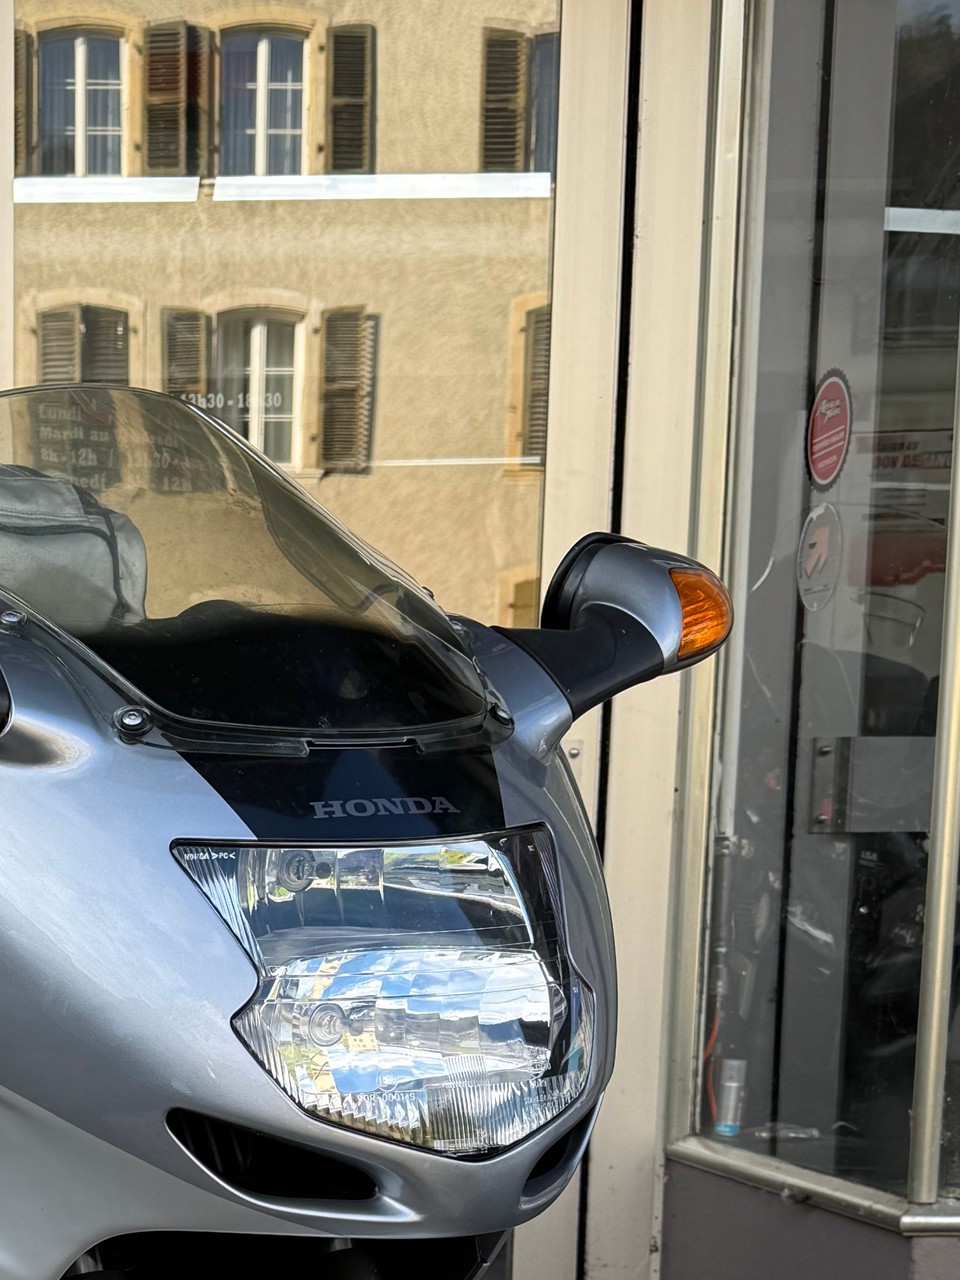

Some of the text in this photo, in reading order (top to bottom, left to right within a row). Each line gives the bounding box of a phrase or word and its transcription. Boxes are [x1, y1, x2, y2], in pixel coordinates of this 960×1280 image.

[38, 403, 82, 422] Lundi
[39, 425, 84, 441] Mardi
[308, 796, 462, 820] HONDA
